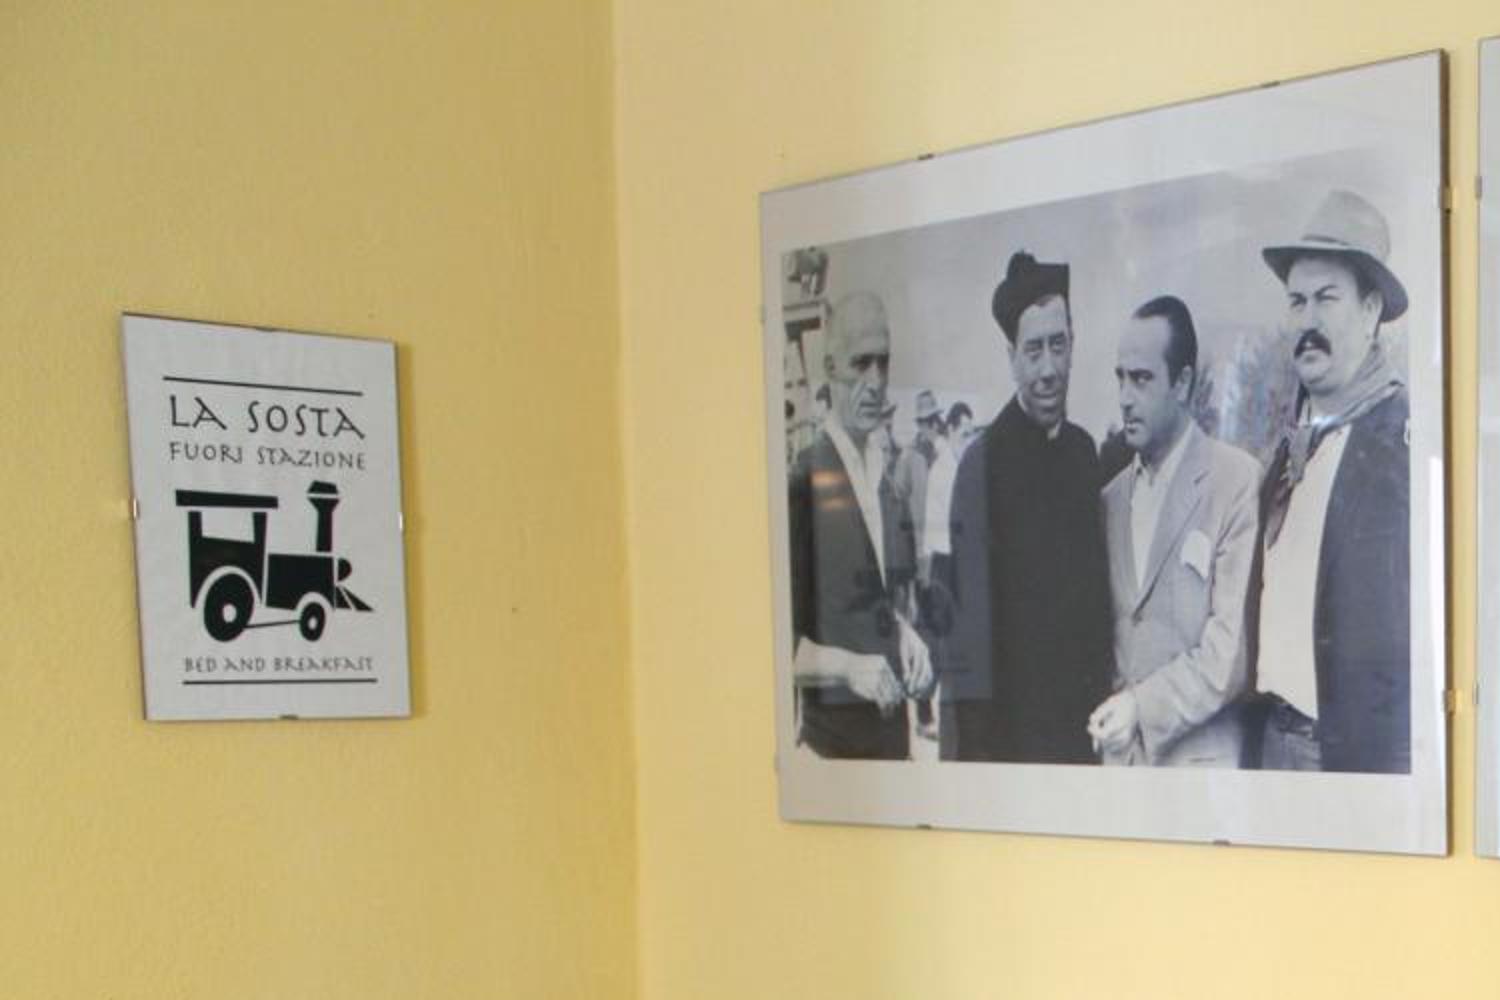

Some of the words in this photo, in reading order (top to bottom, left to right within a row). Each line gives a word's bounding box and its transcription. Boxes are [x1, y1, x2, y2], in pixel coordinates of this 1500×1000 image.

[168, 394, 228, 431] LA
[247, 400, 366, 440] SOSTA
[169, 441, 243, 465] FUORI
[257, 446, 366, 471] STAZIONE
[185, 656, 218, 673] BED
[223, 656, 266, 673] AND
[273, 656, 376, 673] BREAKFAST
